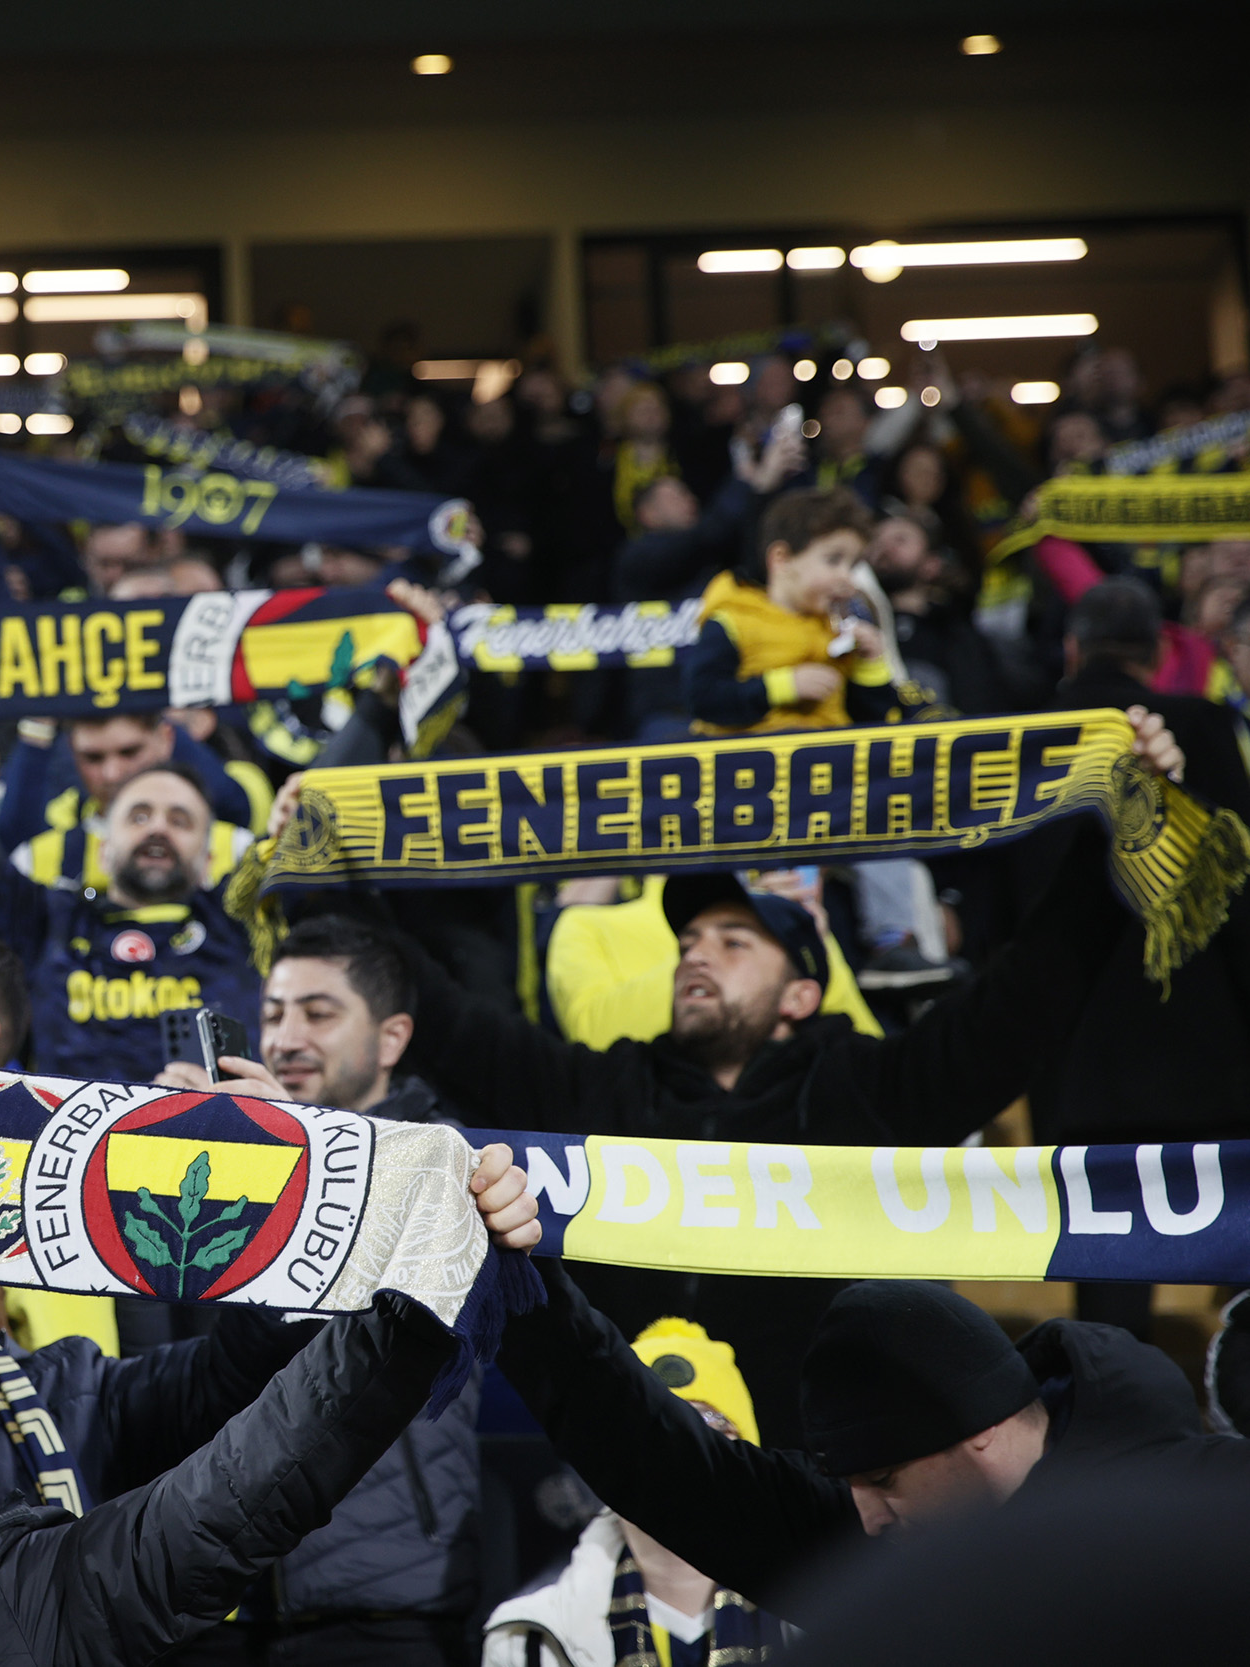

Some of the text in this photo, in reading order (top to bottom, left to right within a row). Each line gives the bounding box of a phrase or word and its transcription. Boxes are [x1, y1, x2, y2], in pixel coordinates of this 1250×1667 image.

[141, 463, 278, 536] 1907
[377, 726, 1082, 866] FENERBAHÇE
[35, 1083, 135, 1271] FENERBA
[287, 1122, 360, 1294] KULÜBÜ
